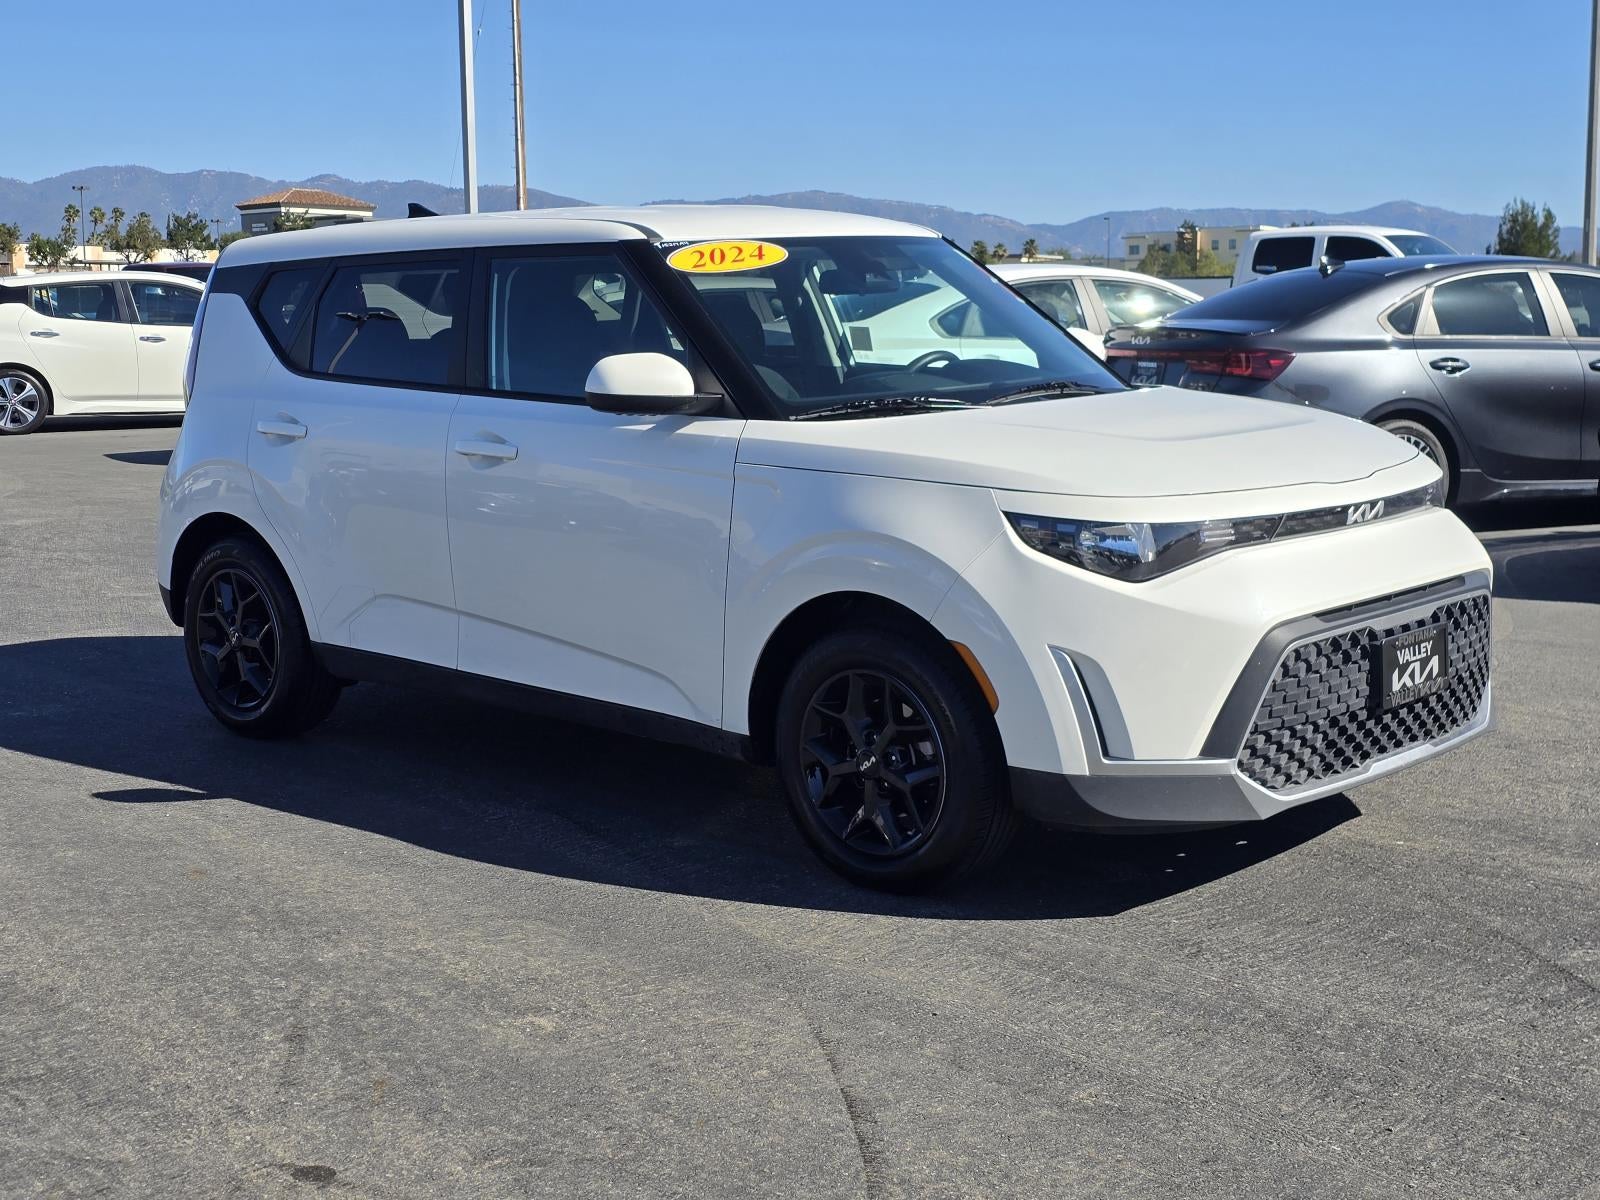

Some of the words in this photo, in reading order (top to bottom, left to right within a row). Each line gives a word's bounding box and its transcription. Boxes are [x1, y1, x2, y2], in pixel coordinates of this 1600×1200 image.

[690, 244, 766, 269] 2024
[1131, 336, 1150, 345] KIA
[1346, 500, 1385, 525] KIA
[1398, 627, 1435, 647] FONTANA
[1396, 640, 1433, 665] VALLEY
[1392, 654, 1439, 692] KIA
[1390, 685, 1420, 708] VALLEY
[860, 755, 876, 771] KIA
